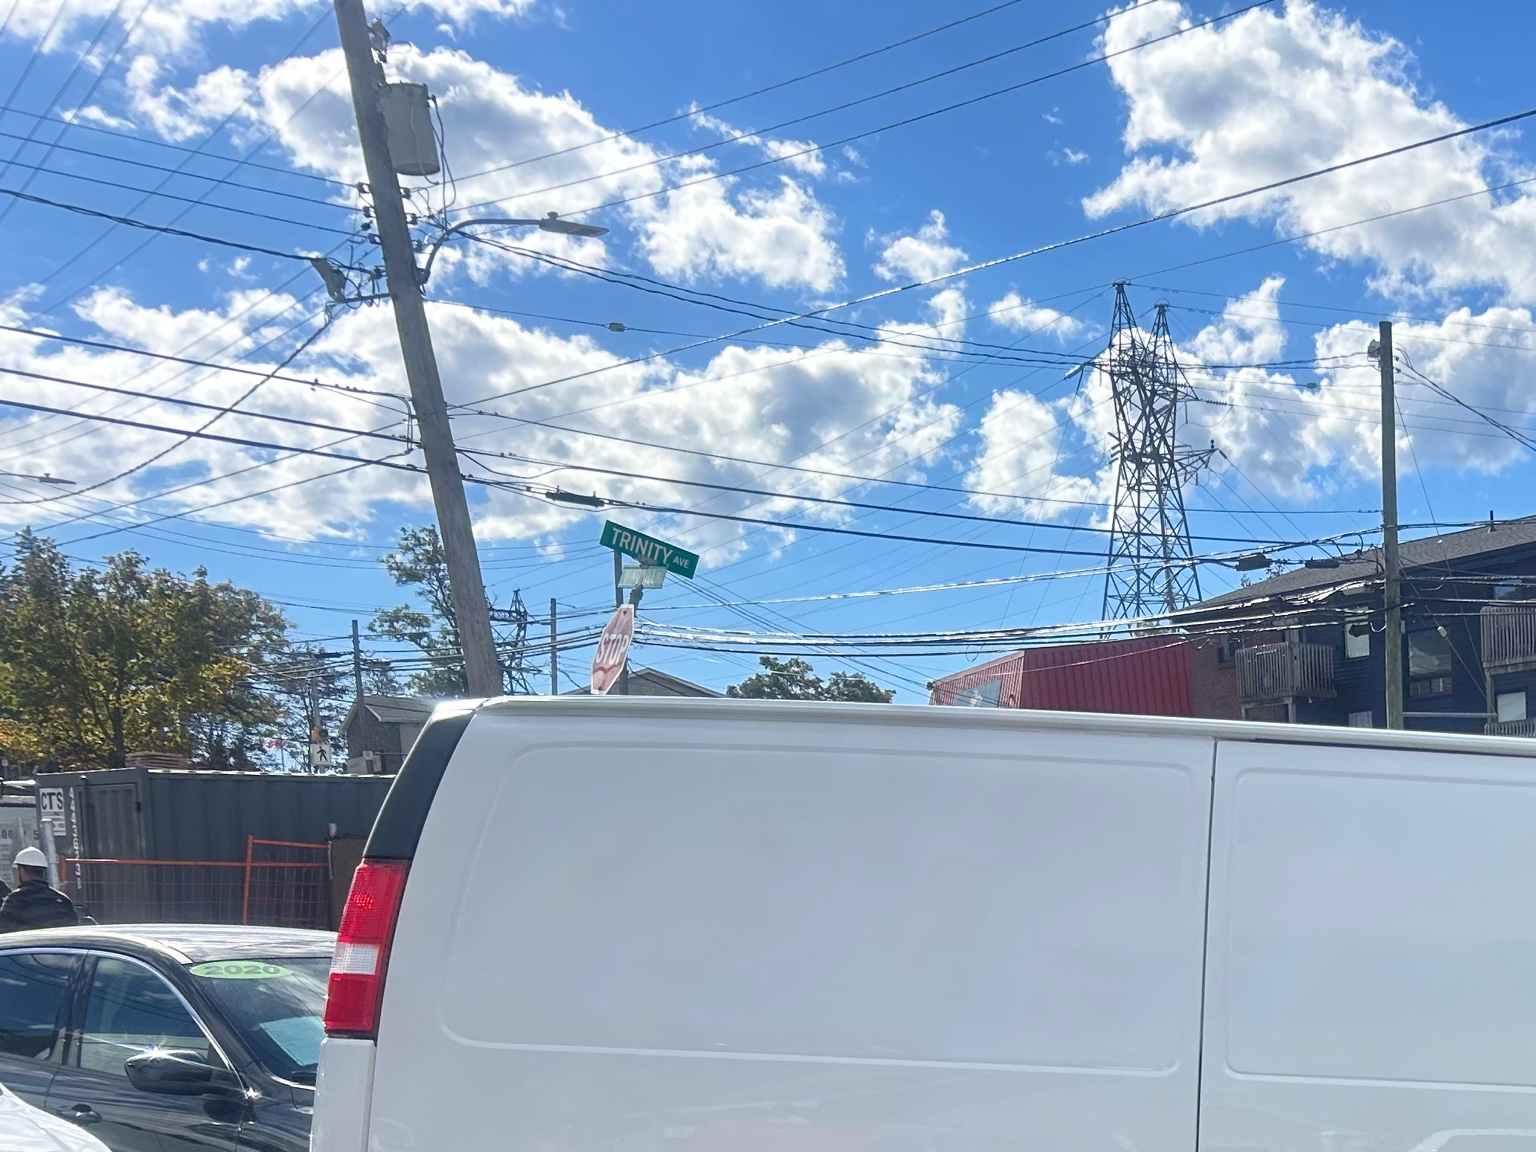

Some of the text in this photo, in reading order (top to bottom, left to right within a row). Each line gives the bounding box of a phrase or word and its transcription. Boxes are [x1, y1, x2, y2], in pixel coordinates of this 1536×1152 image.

[612, 528, 690, 569] TRINITY AVE
[596, 632, 629, 666] STOP
[41, 791, 64, 810] CTS
[204, 965, 280, 975] 2020
